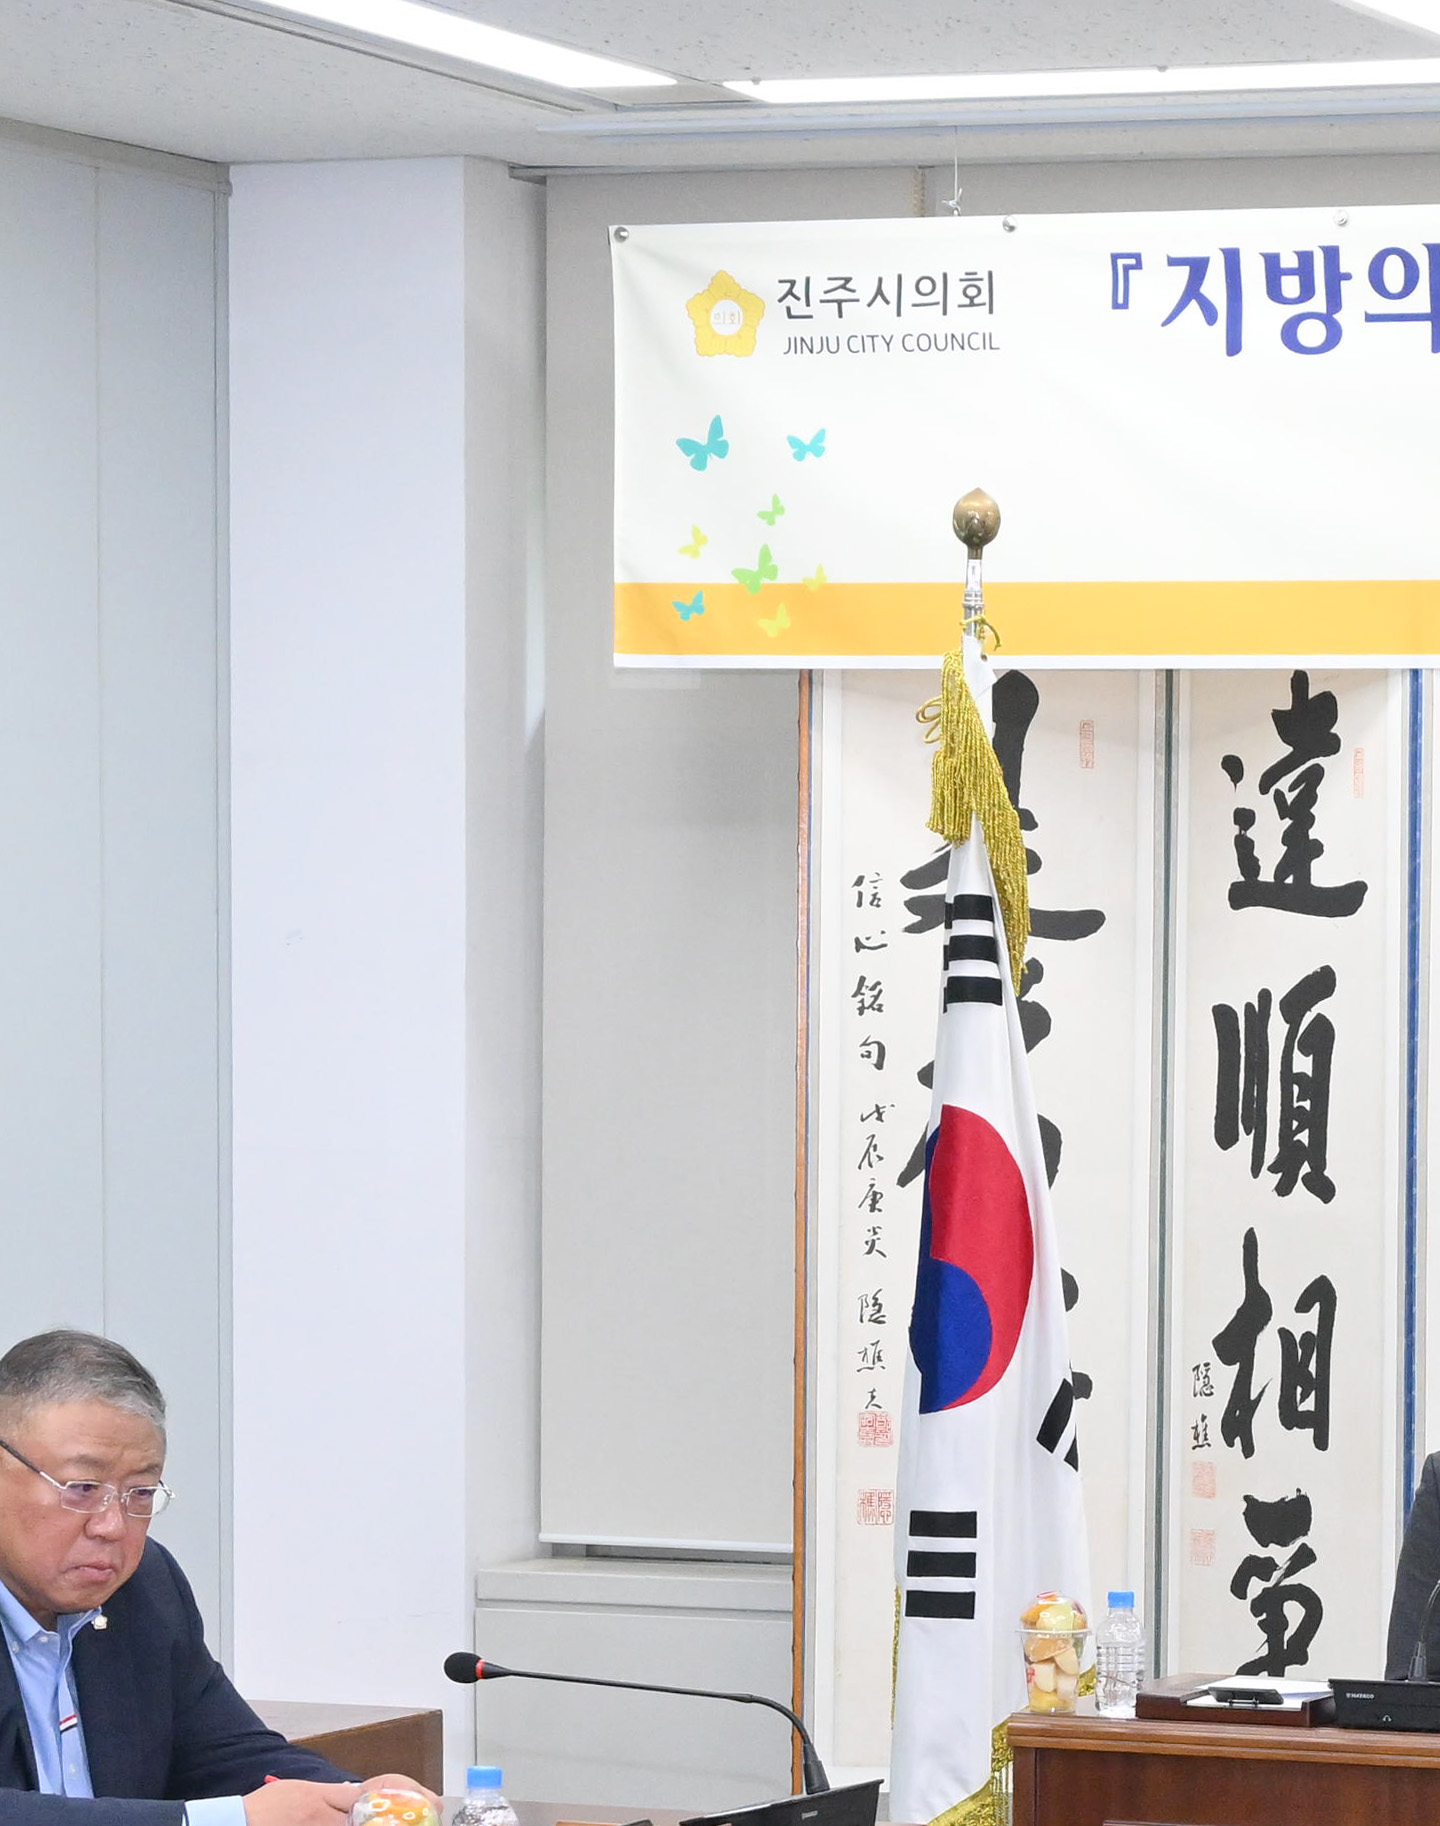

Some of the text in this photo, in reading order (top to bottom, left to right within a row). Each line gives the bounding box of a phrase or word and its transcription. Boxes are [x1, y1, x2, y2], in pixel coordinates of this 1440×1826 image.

[777, 270, 995, 320] 진주시의회
[783, 332, 1001, 355] JINJU CITY COUNCIL
